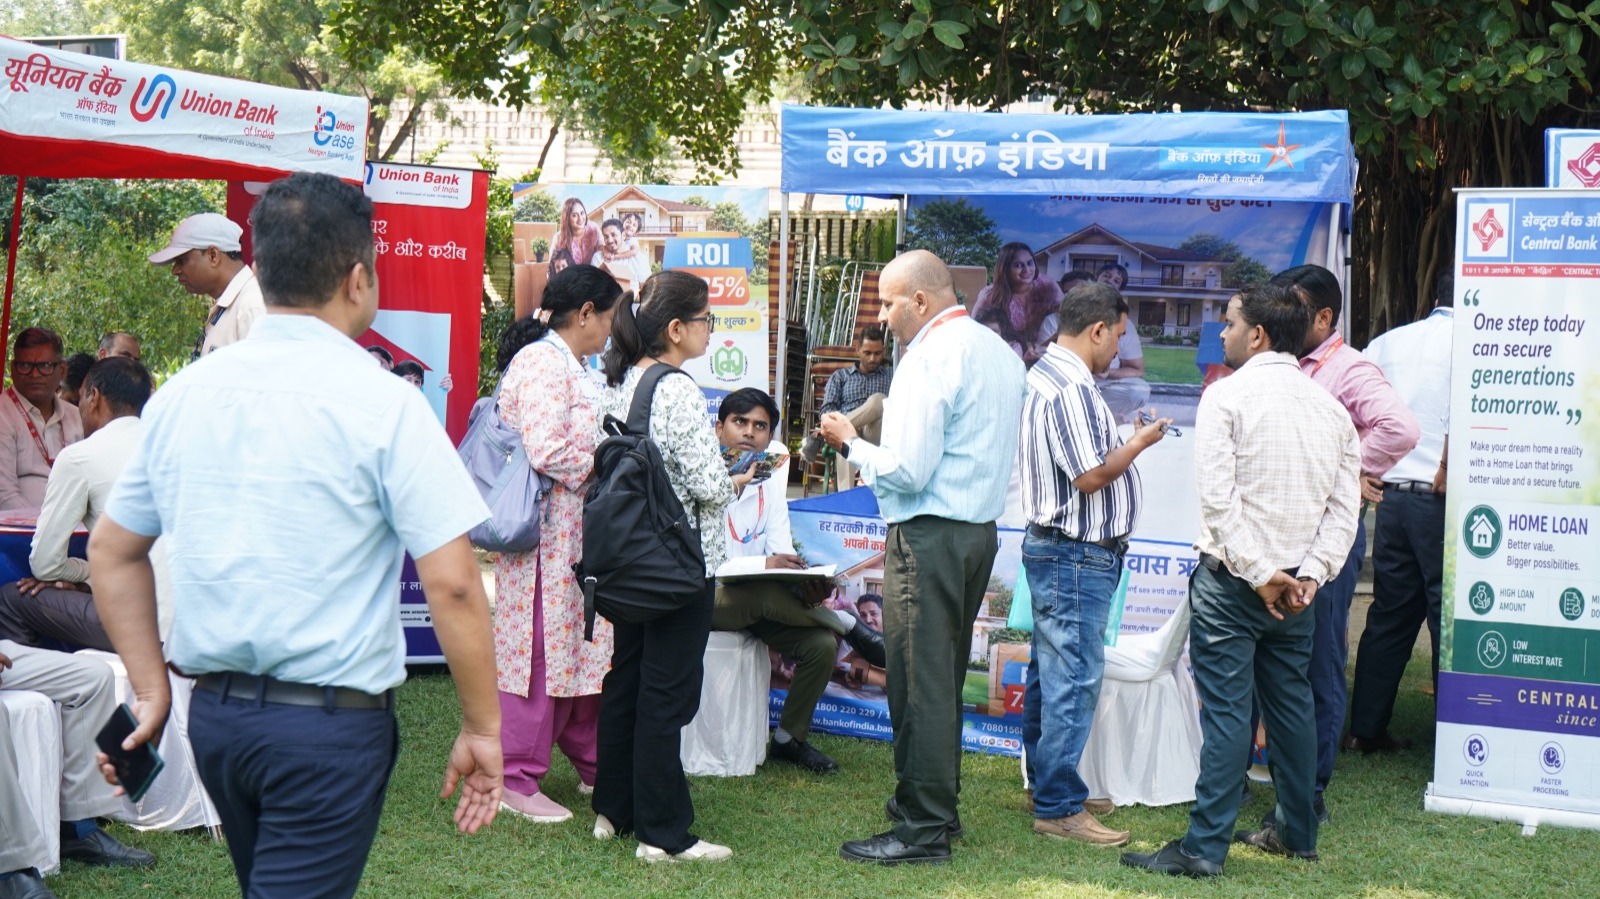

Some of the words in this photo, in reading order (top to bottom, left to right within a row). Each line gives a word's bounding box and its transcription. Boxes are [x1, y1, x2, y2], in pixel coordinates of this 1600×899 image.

[5, 53, 88, 93] यूनियन
[88, 66, 127, 97] बैंक
[76, 96, 94, 110] ऑफ
[95, 100, 117, 114] इंडिया
[180, 89, 232, 117] Union
[234, 98, 279, 125] Bank
[244, 126, 253, 137] of
[254, 128, 275, 140] India
[336, 120, 355, 132] Union
[203, 134, 229, 144] Government
[234, 138, 245, 146] India
[245, 140, 272, 151] Undertaking
[826, 128, 888, 169] बैंक
[900, 129, 986, 173] ऑफ़
[997, 129, 1109, 178] इंडिया
[1167, 148, 1188, 163] बैंक
[1224, 149, 1261, 166] इंडिया
[379, 168, 420, 182] Union
[423, 171, 460, 185] Bank
[1220, 174, 1230, 183] की
[442, 186, 459, 194] India
[847, 195, 861, 209] 40
[1522, 211, 1560, 231] सेन्ट्रल
[1561, 211, 1584, 227] बैंक
[395, 237, 423, 257] और
[428, 240, 468, 261] करीब
[1521, 234, 1564, 251] Central
[1566, 235, 1597, 251] Bank
[687, 243, 730, 265] ROI
[701, 276, 746, 298] 5%
[724, 316, 748, 329] शुल्क
[1473, 312, 1504, 331] One
[1507, 315, 1539, 336] step
[1543, 314, 1585, 337] today
[1472, 342, 1499, 356] can
[1503, 343, 1552, 358] secure
[1470, 365, 1575, 389] generations
[1470, 394, 1560, 416] tomorrow.
[1470, 441, 1489, 451] Make
[1491, 443, 1506, 454] your
[1508, 443, 1531, 453] dream
[1532, 443, 1552, 454] home
[1554, 446, 1558, 454] a
[1560, 445, 1583, 458] reality
[1470, 458, 1485, 468] with
[1486, 460, 1491, 468] a
[1493, 459, 1513, 469] Home
[1515, 459, 1533, 470] Loan
[1534, 460, 1549, 471] that
[1551, 461, 1573, 474] brings
[1469, 474, 1490, 484] better
[1492, 475, 1510, 486] value
[1512, 476, 1525, 486] and
[1527, 478, 1531, 486] a
[1533, 479, 1557, 488] secure
[1558, 478, 1582, 489] future.
[819, 520, 832, 532] हर
[834, 521, 864, 535] तरक्की
[865, 522, 878, 536] की
[1508, 514, 1548, 533] HOME
[1552, 516, 1588, 535] LOAN
[843, 537, 869, 551] अपनी
[1507, 539, 1531, 550] Better
[1533, 540, 1555, 552] value.
[1507, 555, 1531, 569] Bigger
[1533, 558, 1580, 571] possibilities.
[1500, 588, 1516, 598] HIGH
[1517, 589, 1534, 599] LOAN
[1499, 602, 1526, 612] AMOUNT
[1513, 640, 1528, 650] LOW
[1512, 654, 1544, 665] INTEREST
[1545, 657, 1563, 667] RATE
[1518, 689, 1599, 710] CENTRAL
[815, 702, 838, 712] 1800
[840, 705, 857, 714] 220
[859, 707, 876, 717] 229
[1556, 711, 1597, 727] since
[965, 736, 977, 744] on
[1466, 769, 1484, 778] QUICK
[1540, 777, 1562, 786] FASTER
[1460, 778, 1489, 788] SANCTION
[1533, 787, 1569, 796] PROCESSING
